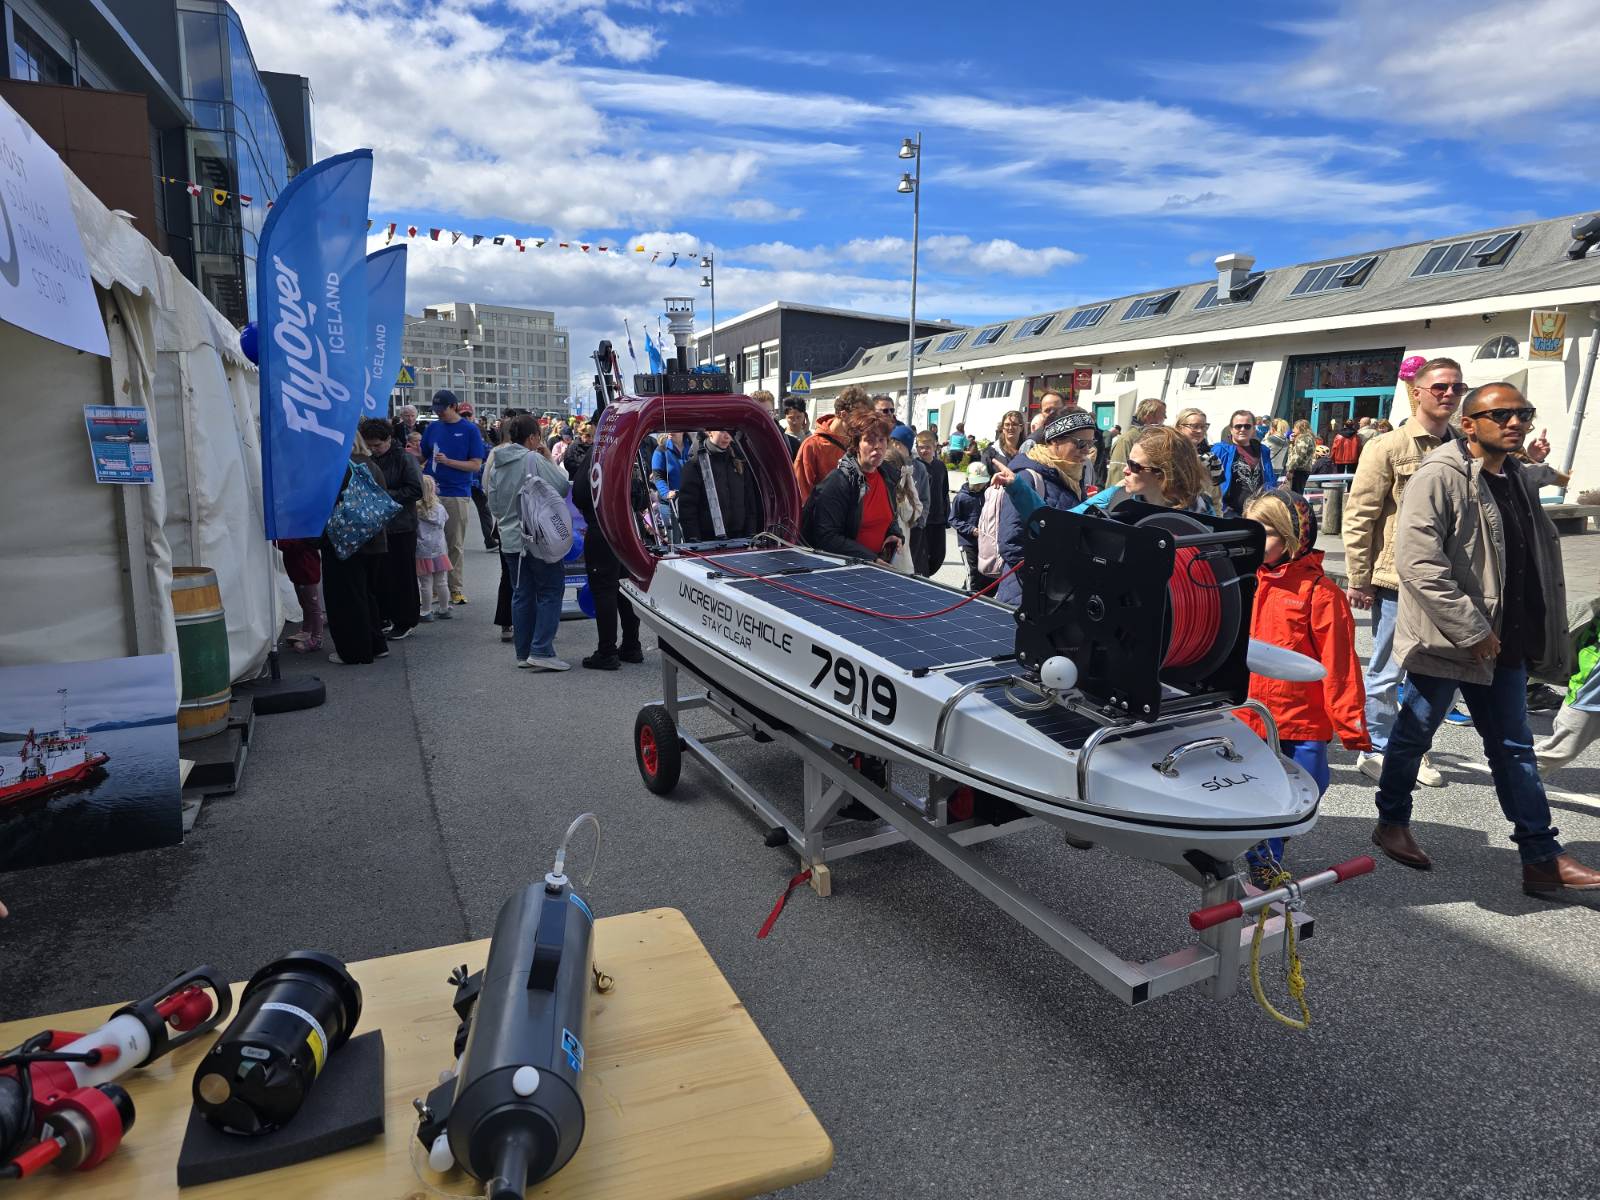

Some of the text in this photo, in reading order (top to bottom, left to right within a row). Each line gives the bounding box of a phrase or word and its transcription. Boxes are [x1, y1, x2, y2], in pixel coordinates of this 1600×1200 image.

[326, 272, 346, 354] ICELAND
[273, 255, 351, 446] FlyOver
[373, 324, 387, 379] ICELAND
[679, 581, 793, 654] UNCREWED VEHICLE
[702, 614, 752, 652] STAY CLEAR
[810, 643, 897, 726] 7919
[1201, 774, 1260, 792] SÚLA
